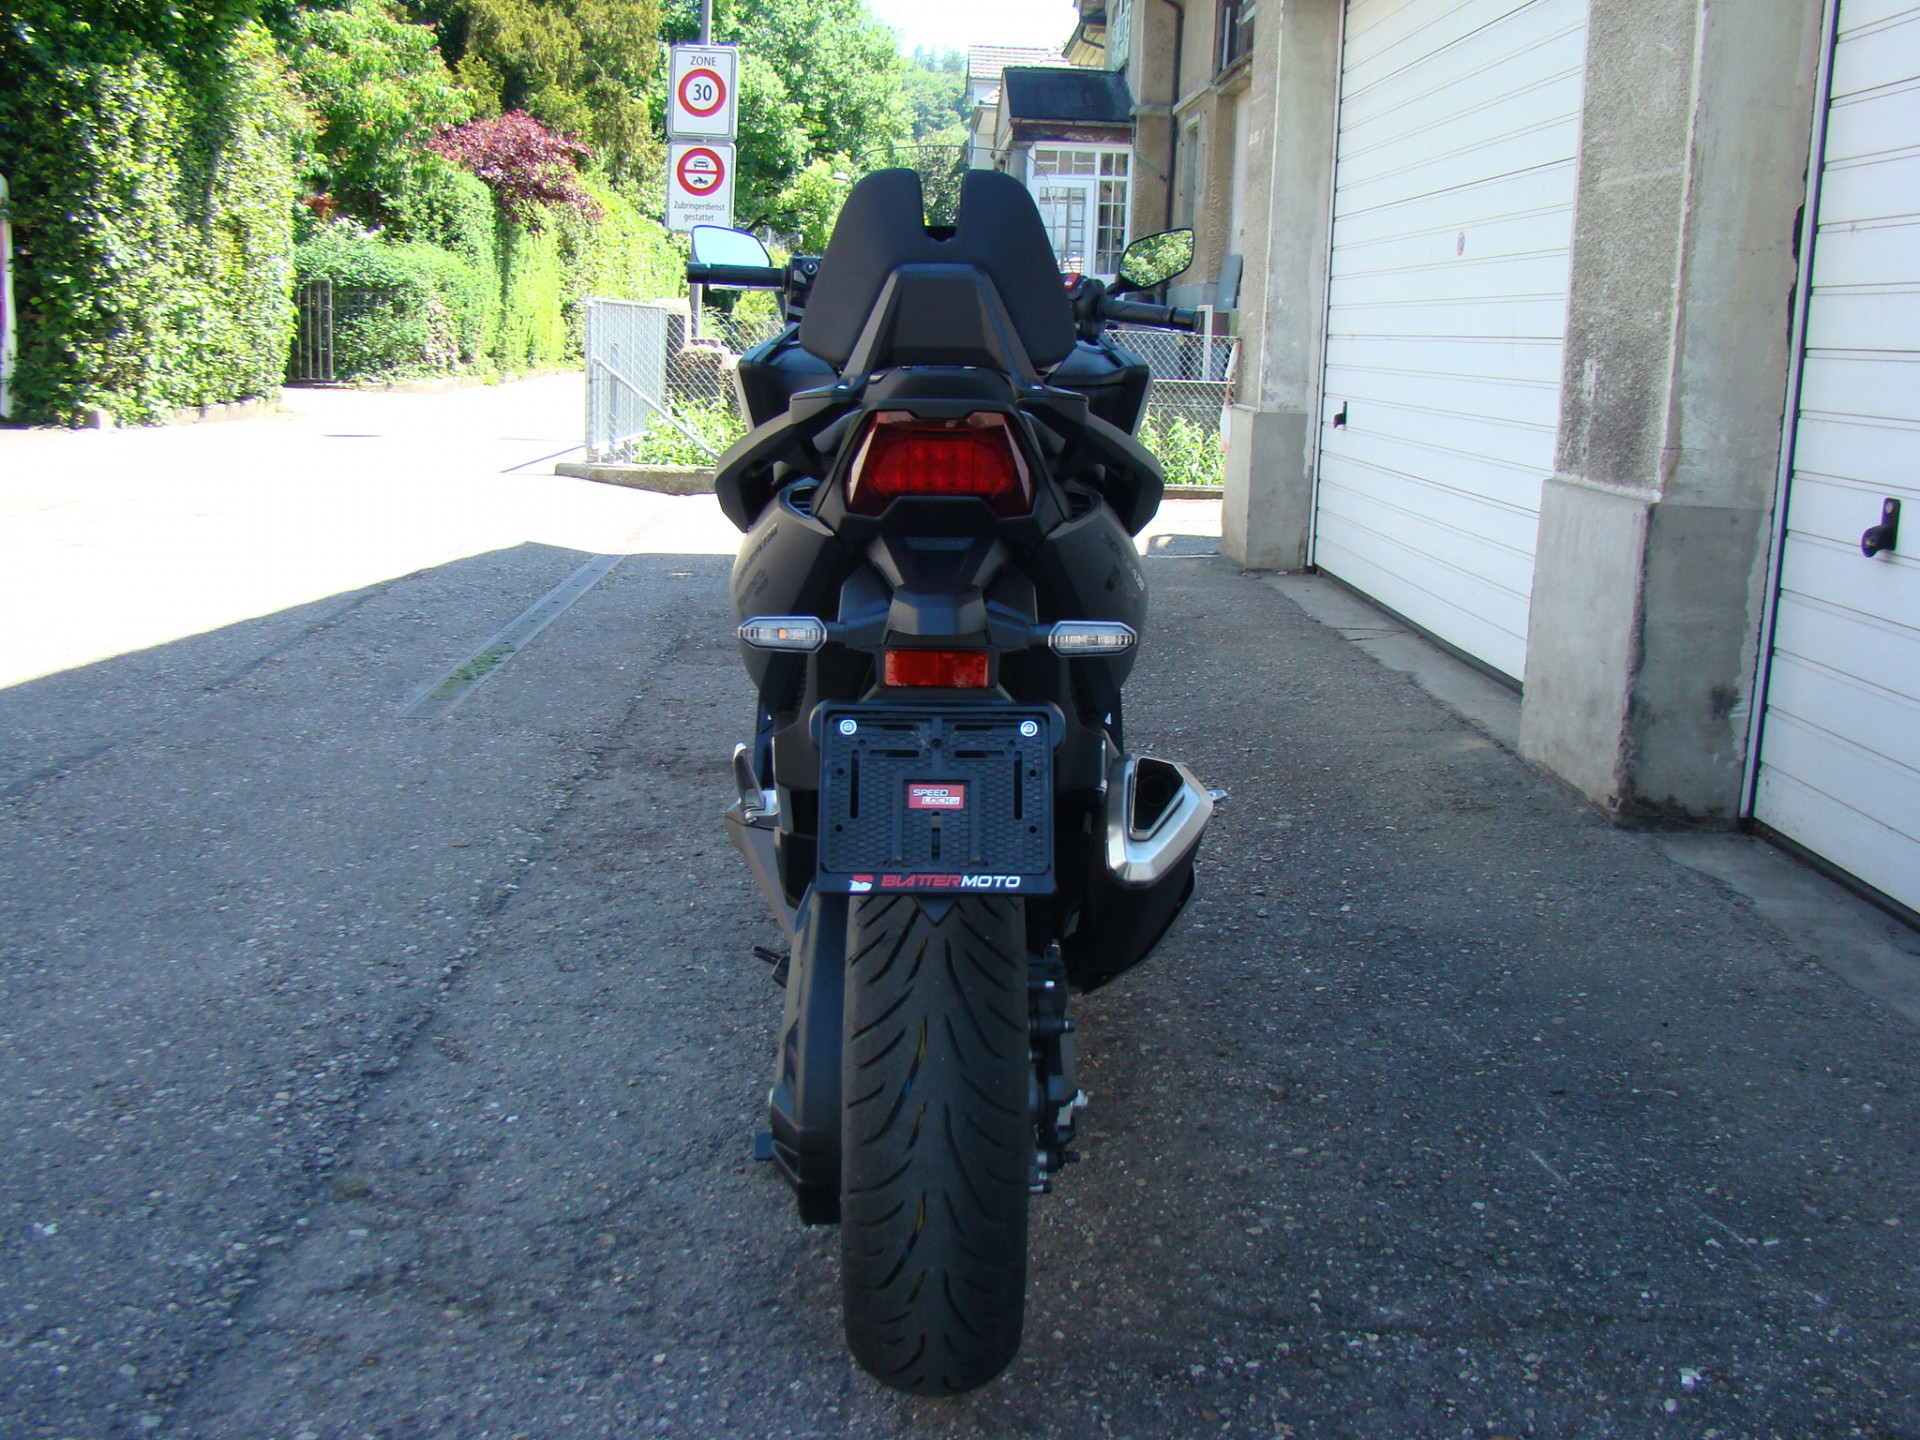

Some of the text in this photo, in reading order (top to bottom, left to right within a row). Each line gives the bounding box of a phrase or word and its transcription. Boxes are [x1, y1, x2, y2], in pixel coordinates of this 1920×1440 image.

[690, 56, 717, 67] ZONE
[693, 83, 712, 101] 30
[674, 200, 725, 212] Zubringerdienst
[683, 212, 714, 222] gestattet
[912, 788, 949, 796] SPEED
